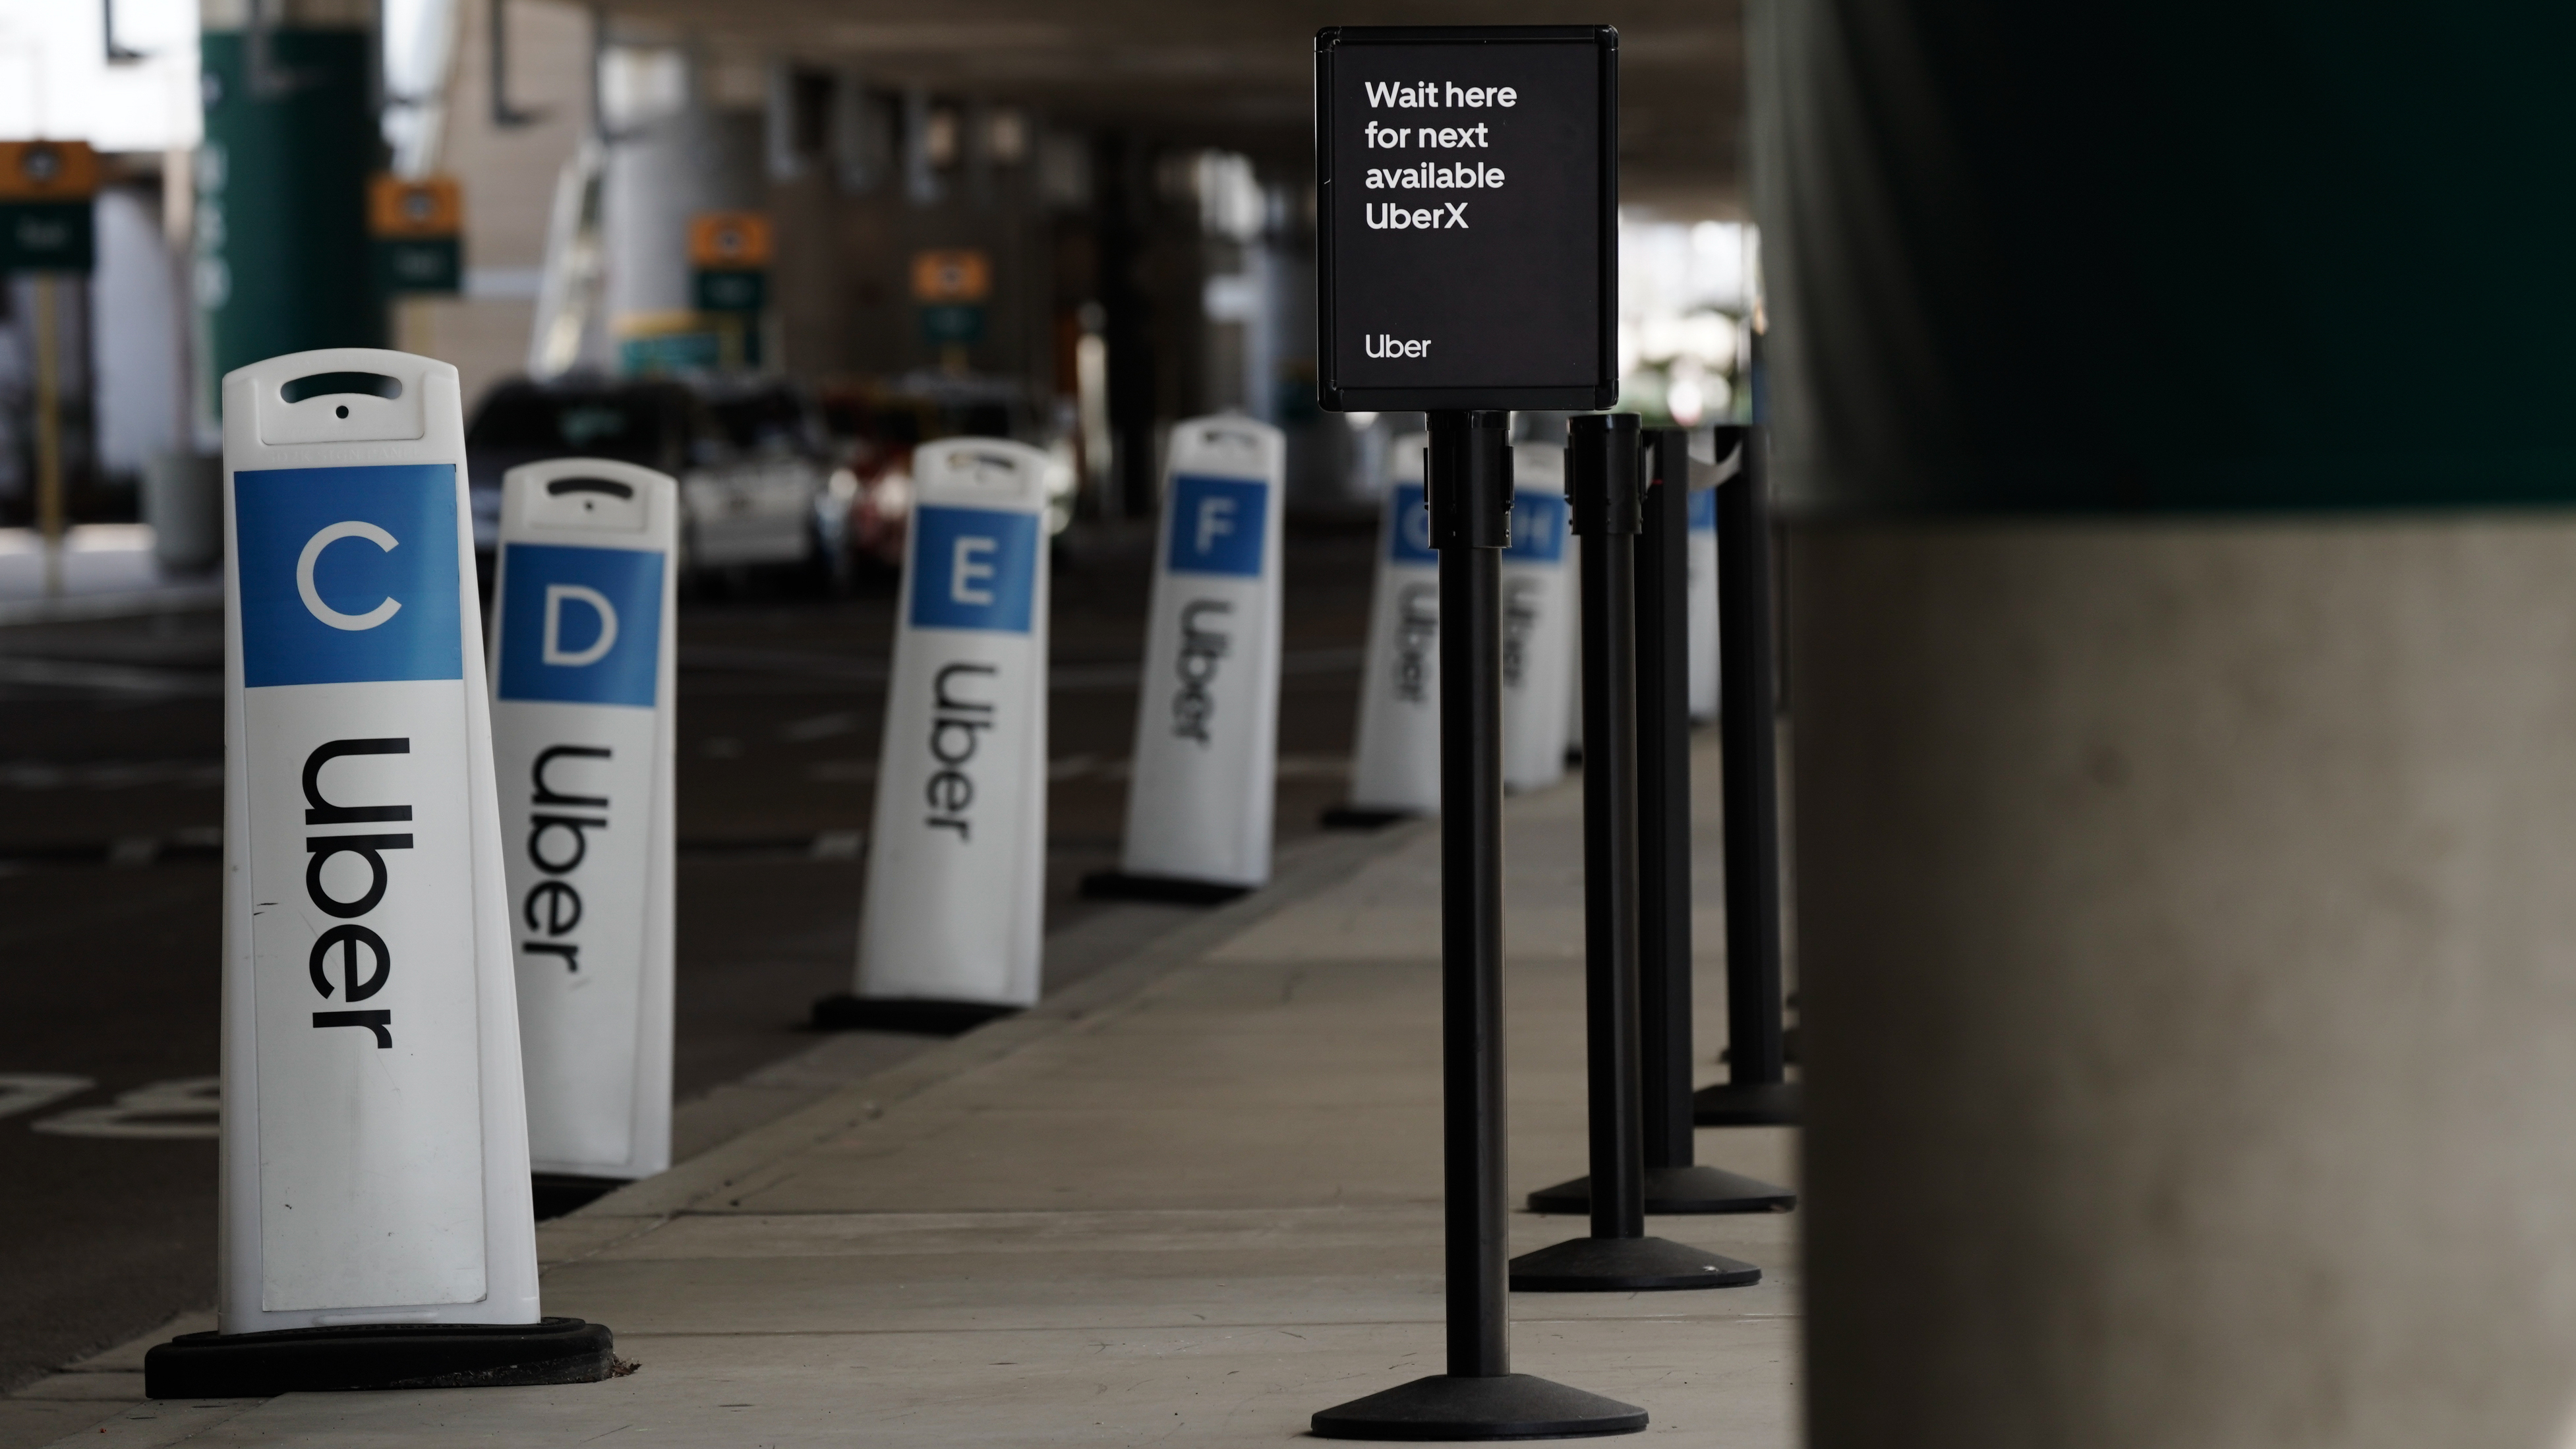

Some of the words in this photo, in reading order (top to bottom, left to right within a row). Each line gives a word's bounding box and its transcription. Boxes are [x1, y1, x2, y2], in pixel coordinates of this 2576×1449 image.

[1365, 81, 1439, 108] Wait
[1446, 81, 1517, 108] here
[1365, 121, 1411, 149] for
[1419, 123, 1489, 148] next
[1365, 162, 1506, 189] available
[1366, 202, 1469, 229] UberX
[1365, 334, 1432, 359] Uber
[1194, 496, 1237, 555] F
[296, 520, 402, 631] C
[950, 535, 999, 606] E
[542, 583, 619, 666] D
[1170, 597, 1235, 749] Uber
[923, 661, 999, 843] Uber
[301, 737, 414, 1050] Uber
[521, 744, 613, 974] Uber
